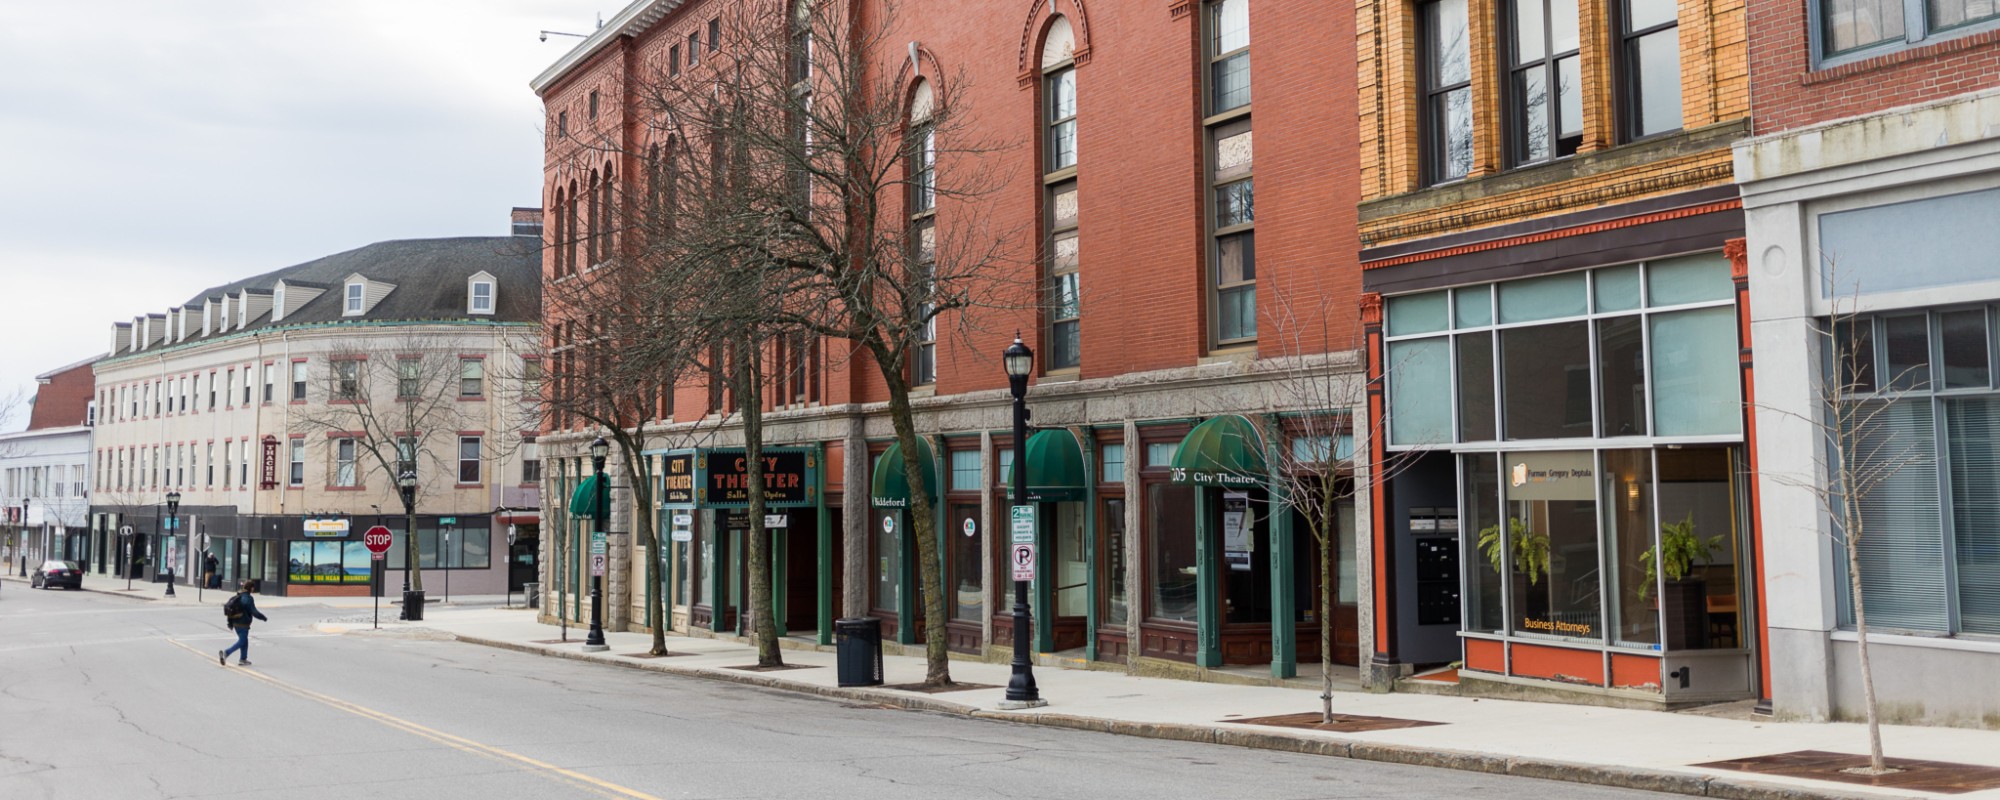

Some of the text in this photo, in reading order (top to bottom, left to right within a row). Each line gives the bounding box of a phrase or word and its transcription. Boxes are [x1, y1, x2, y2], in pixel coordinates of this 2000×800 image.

[671, 459, 686, 473] CITY
[735, 457, 778, 472] CY
[714, 473, 799, 488] THETER
[1193, 472, 1213, 484] City
[1216, 472, 1256, 484] Theater
[1528, 468, 1592, 479] Furman Gregory Deptula
[665, 474, 692, 490] THEATER
[726, 490, 746, 499] Salle
[1013, 508, 1019, 518] 2
[366, 534, 391, 545] STOP
[1020, 549, 1030, 563] P
[1524, 617, 1591, 635] Business Attorneys
